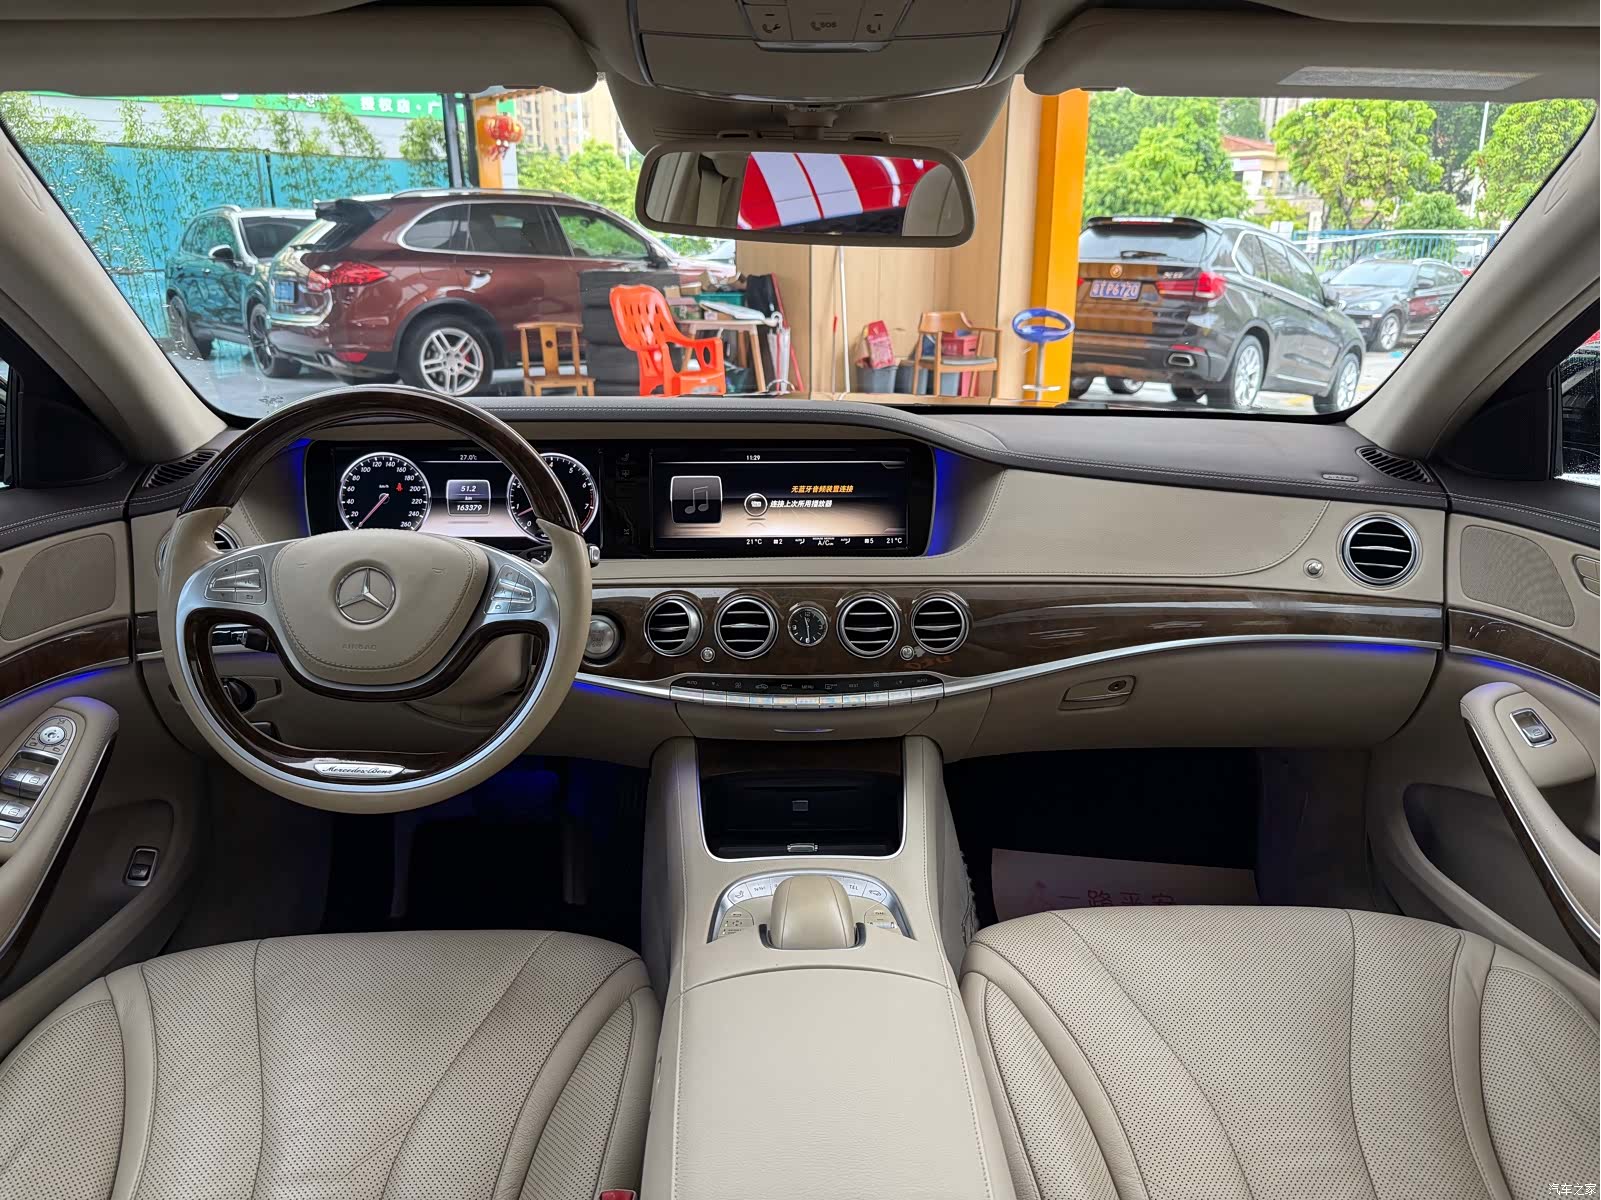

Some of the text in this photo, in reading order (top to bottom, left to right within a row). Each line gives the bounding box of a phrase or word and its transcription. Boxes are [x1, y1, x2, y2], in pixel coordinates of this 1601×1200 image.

[791, 485, 854, 494] 无蓝牙音频装置连接
[456, 504, 482, 512] 163379
[769, 500, 833, 508] 连接上次所用播放器
